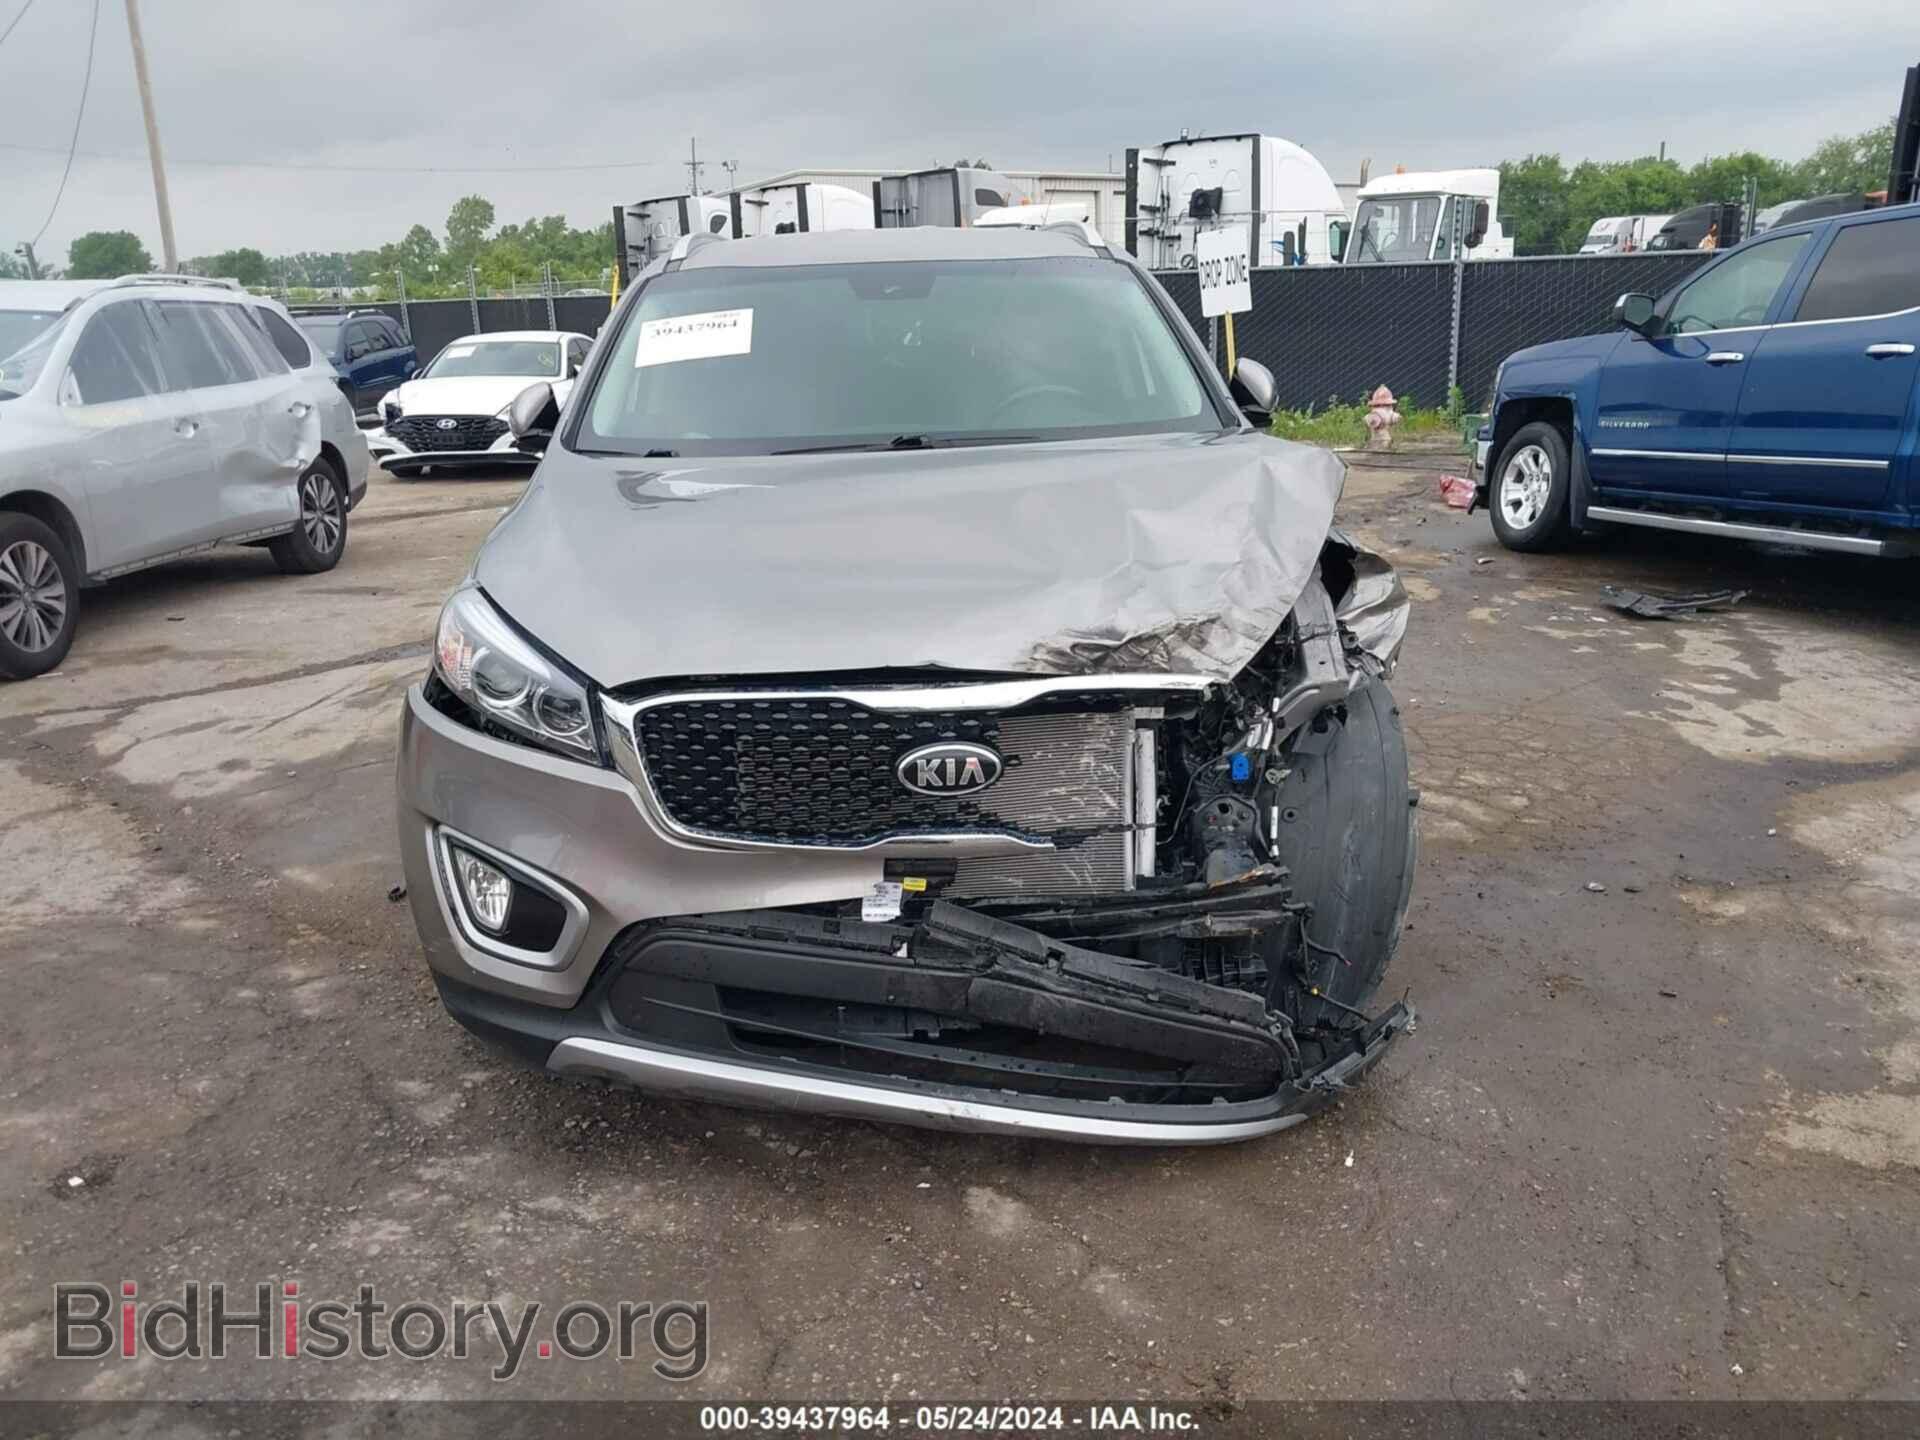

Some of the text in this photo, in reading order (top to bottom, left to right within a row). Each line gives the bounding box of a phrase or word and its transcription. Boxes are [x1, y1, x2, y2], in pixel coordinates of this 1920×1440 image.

[1199, 253, 1248, 290] DROP ZONE
[916, 757, 985, 786] KIA
